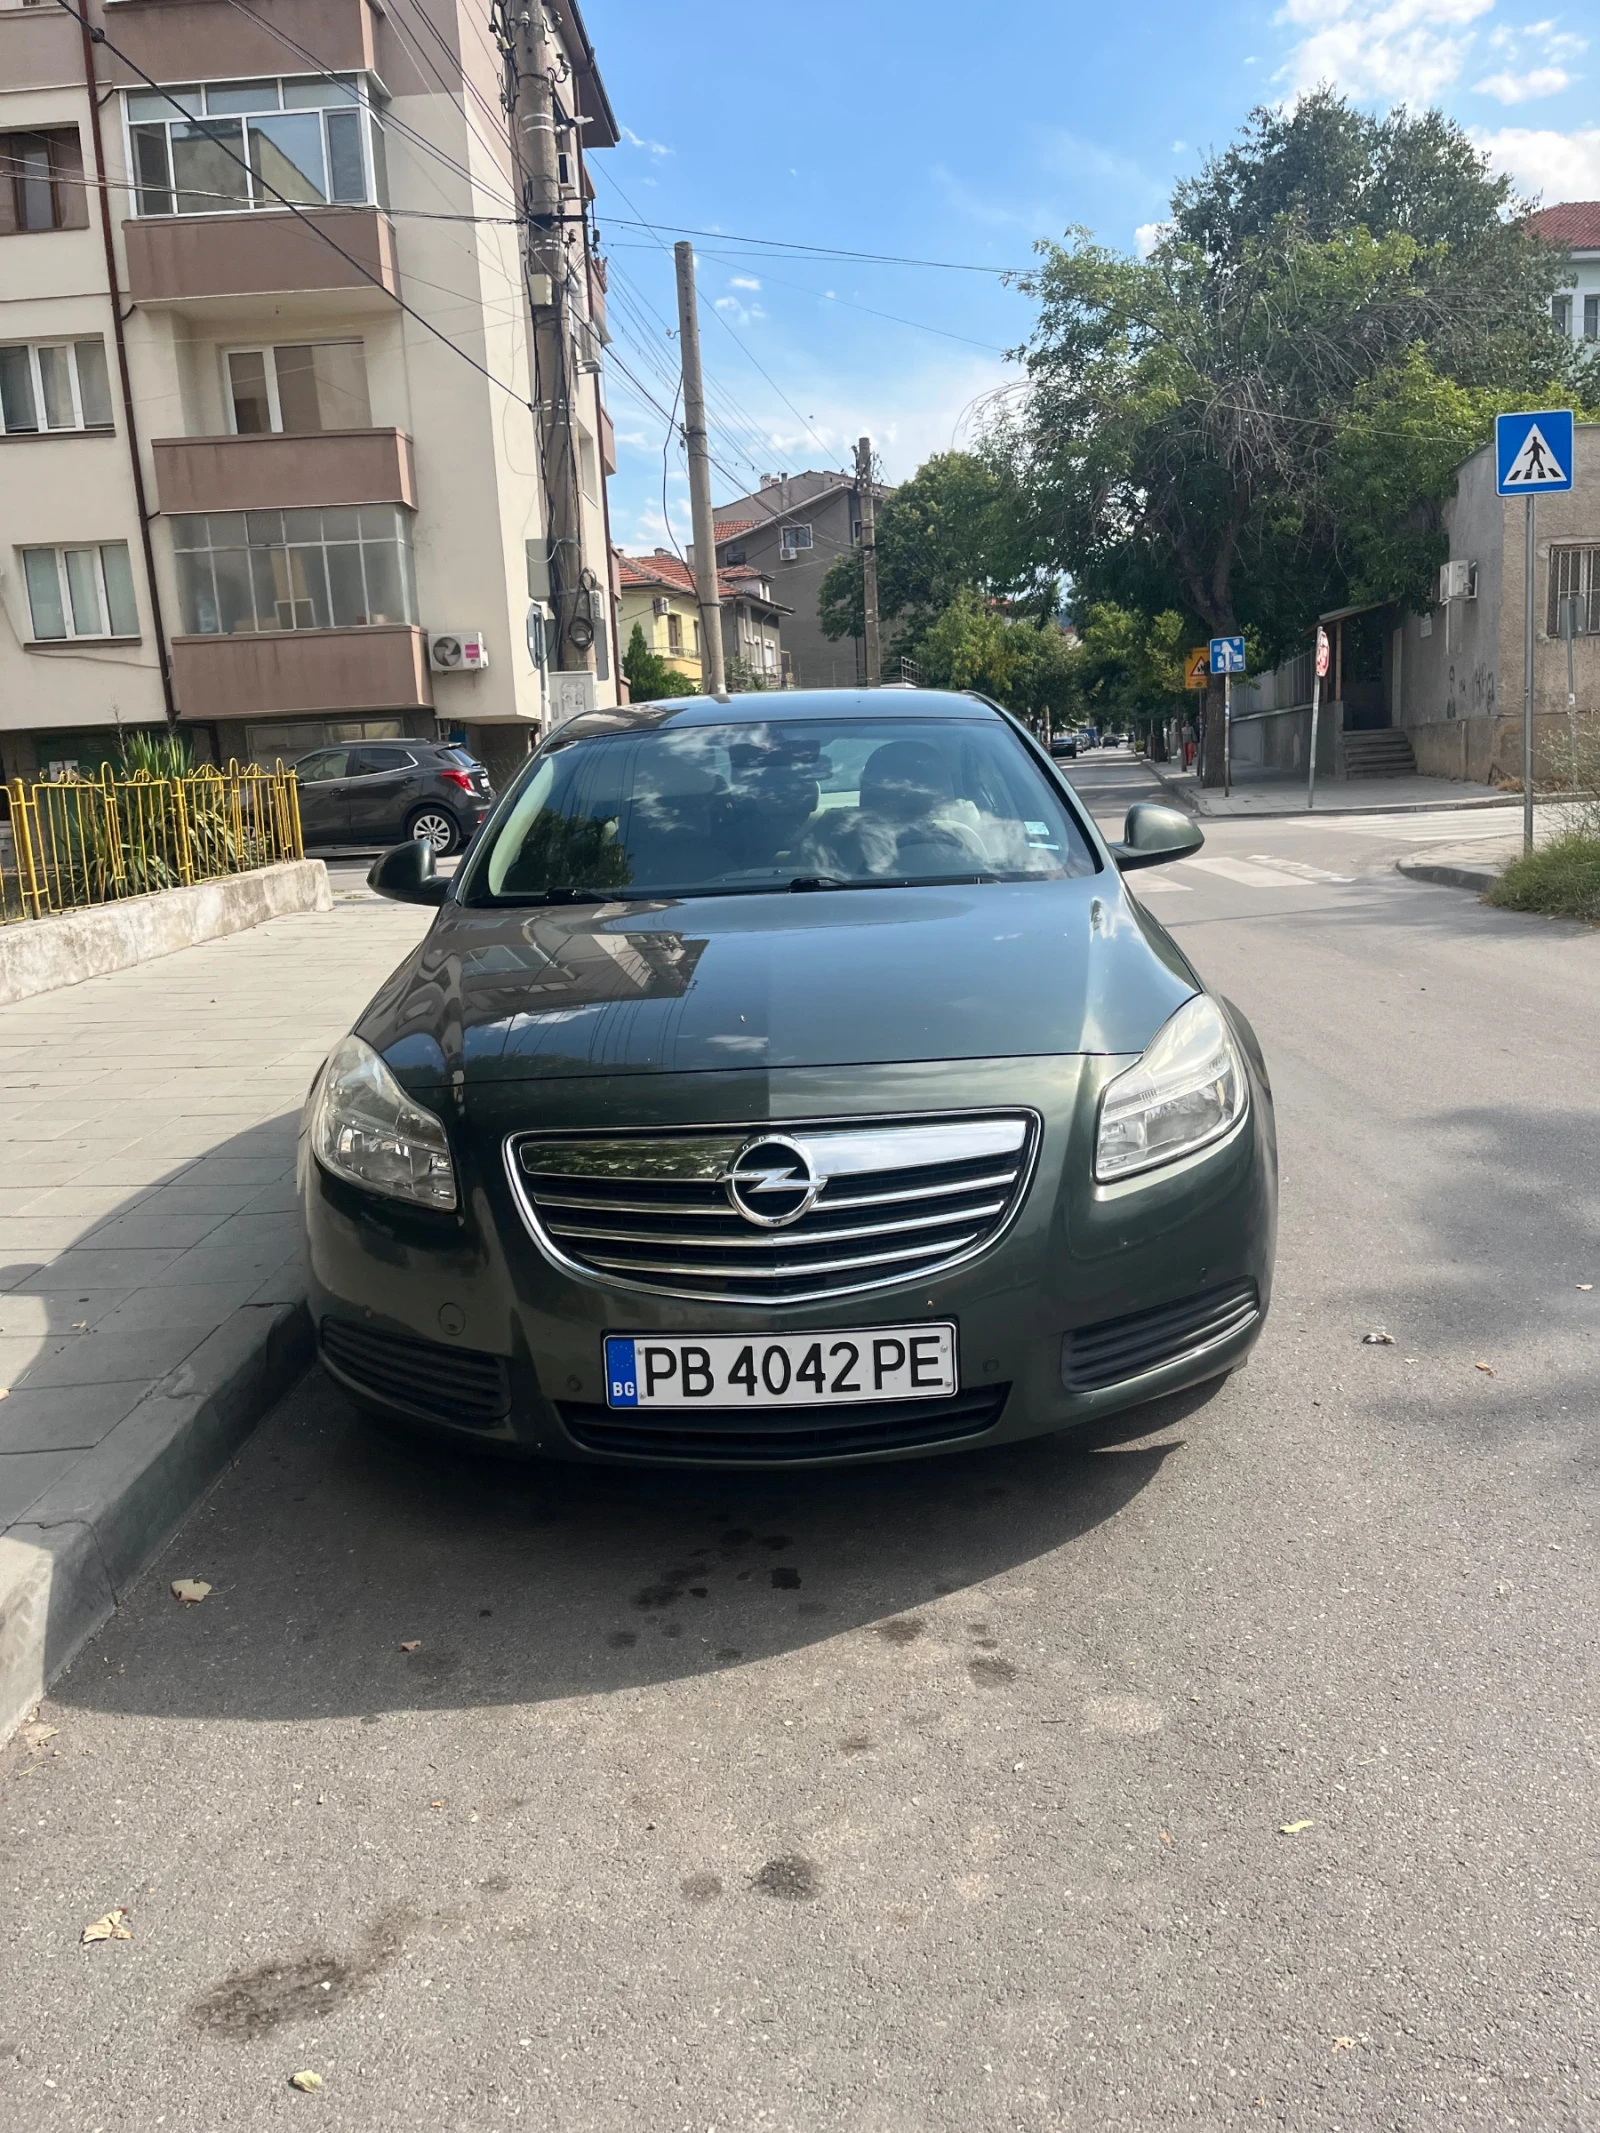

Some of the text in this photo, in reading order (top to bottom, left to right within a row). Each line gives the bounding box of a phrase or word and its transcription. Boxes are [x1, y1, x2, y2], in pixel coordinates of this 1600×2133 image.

[742, 1135, 797, 1151] OP
[645, 1335, 943, 1397] PB 4042 PE
[613, 1381, 635, 1397] BG
